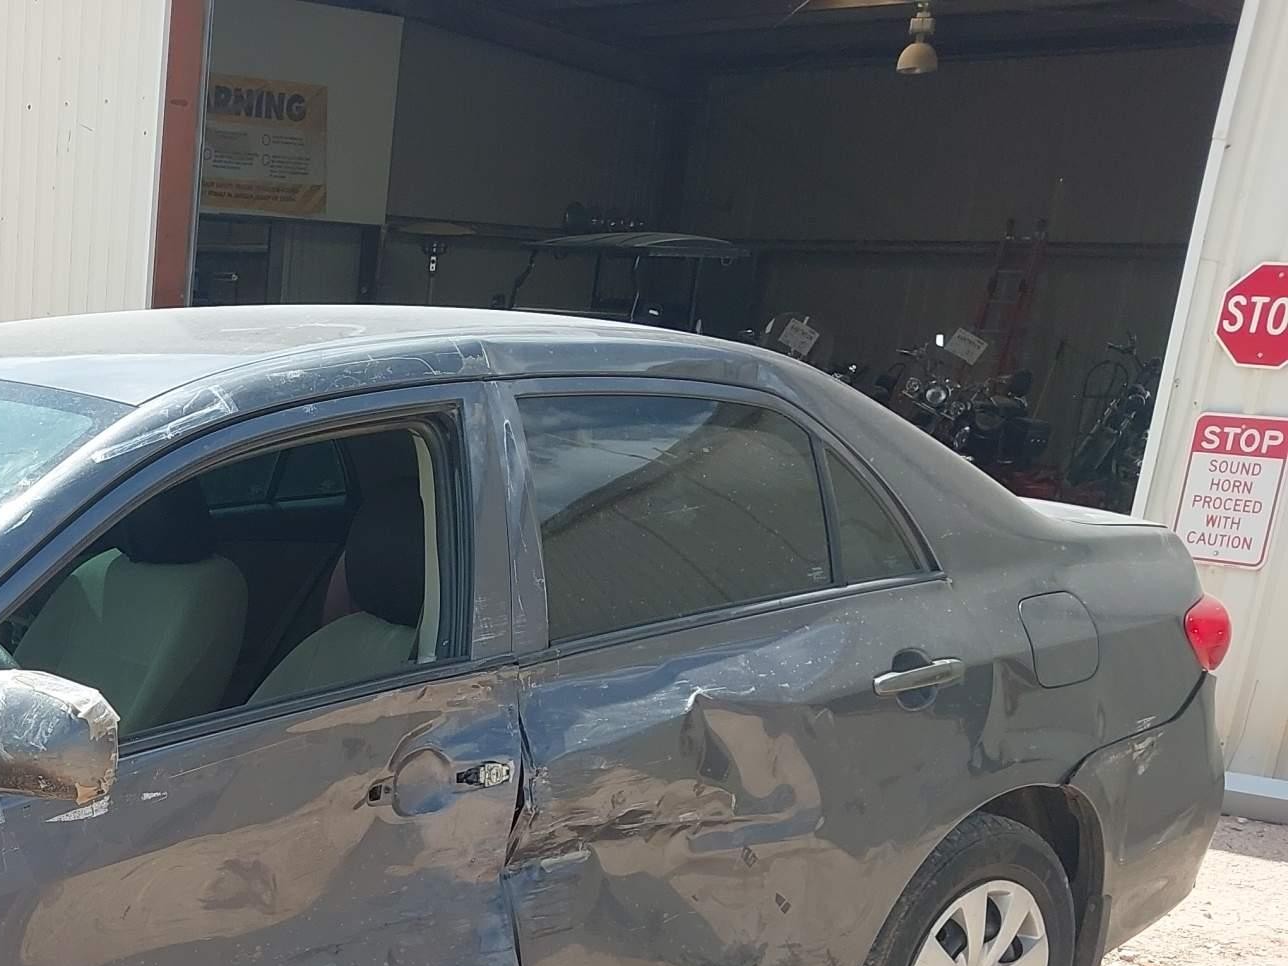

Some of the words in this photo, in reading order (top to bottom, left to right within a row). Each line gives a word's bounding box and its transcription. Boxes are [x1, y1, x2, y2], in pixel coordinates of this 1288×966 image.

[208, 85, 306, 122] RNING
[1223, 295, 1288, 335] STO
[1201, 426, 1284, 454] STOP
[1208, 459, 1262, 476] SOUND
[1209, 478, 1253, 494] HORN
[1192, 494, 1263, 514] PROCEED
[1206, 514, 1241, 530] WITH
[1187, 531, 1253, 550] CAUTION
